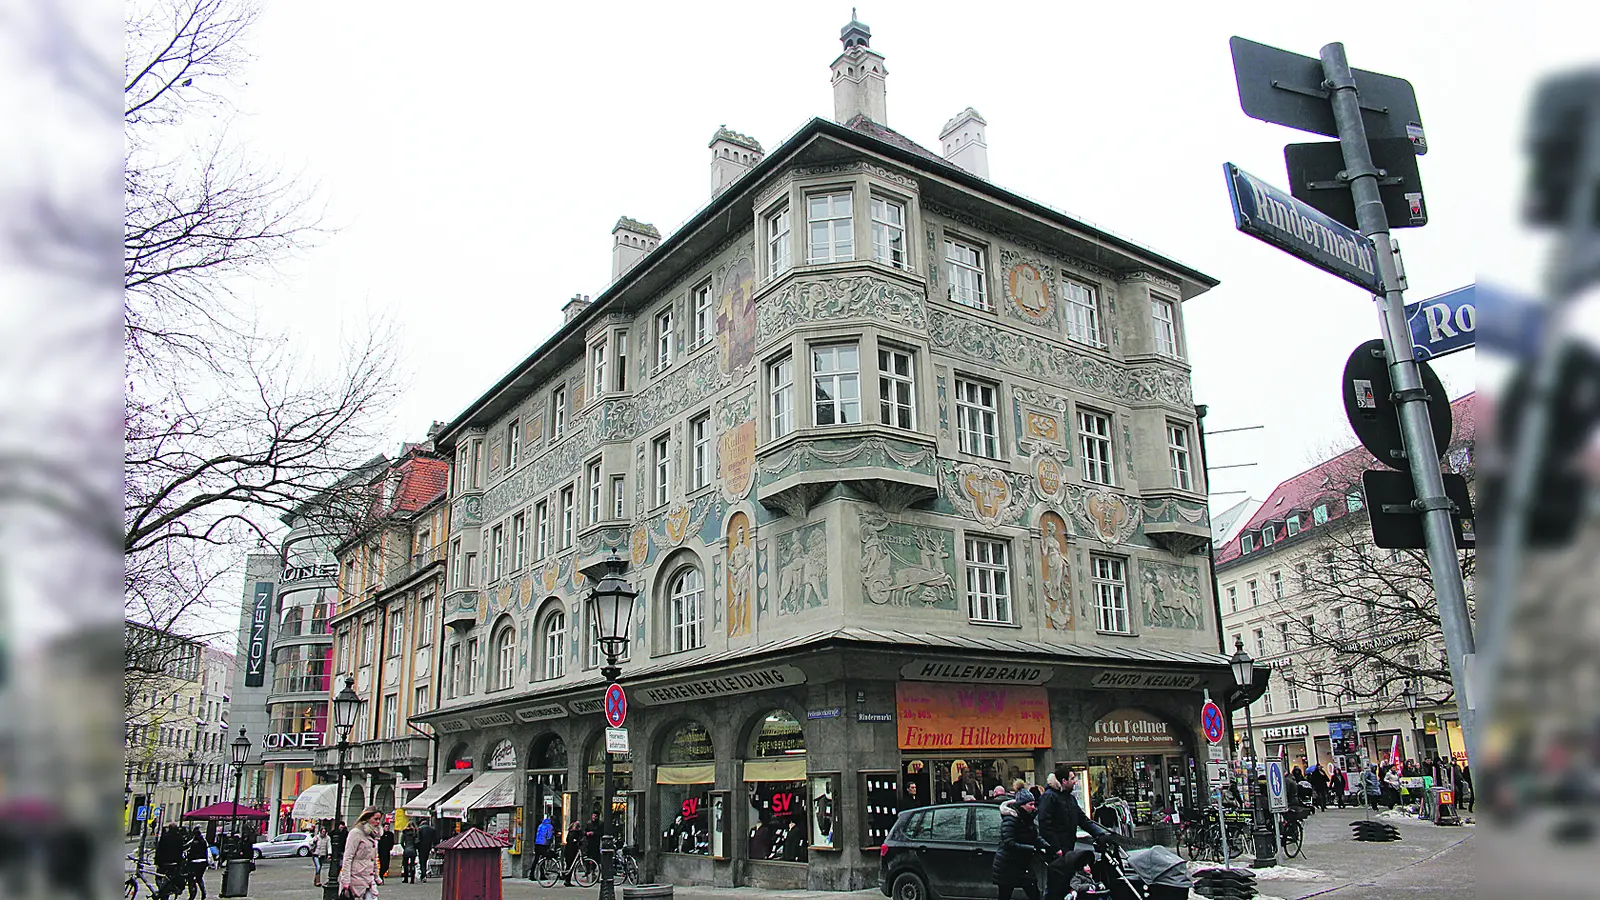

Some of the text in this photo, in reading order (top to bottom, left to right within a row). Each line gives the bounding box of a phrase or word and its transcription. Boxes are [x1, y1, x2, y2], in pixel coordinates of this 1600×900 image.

[1251, 182, 1375, 276] Rindermarkt
[249, 593, 268, 675] KONEN
[920, 662, 1041, 681] HILLENBRAND
[1099, 673, 1195, 688] PHOTO KELLNER
[647, 668, 785, 702] HERRENBEKLEIDUNG
[573, 699, 605, 713] SCHNITZ
[904, 726, 1046, 746] Firma Hillenbrand
[1094, 720, 1168, 734] Foto Kellner
[1261, 725, 1307, 738] TRETTER
